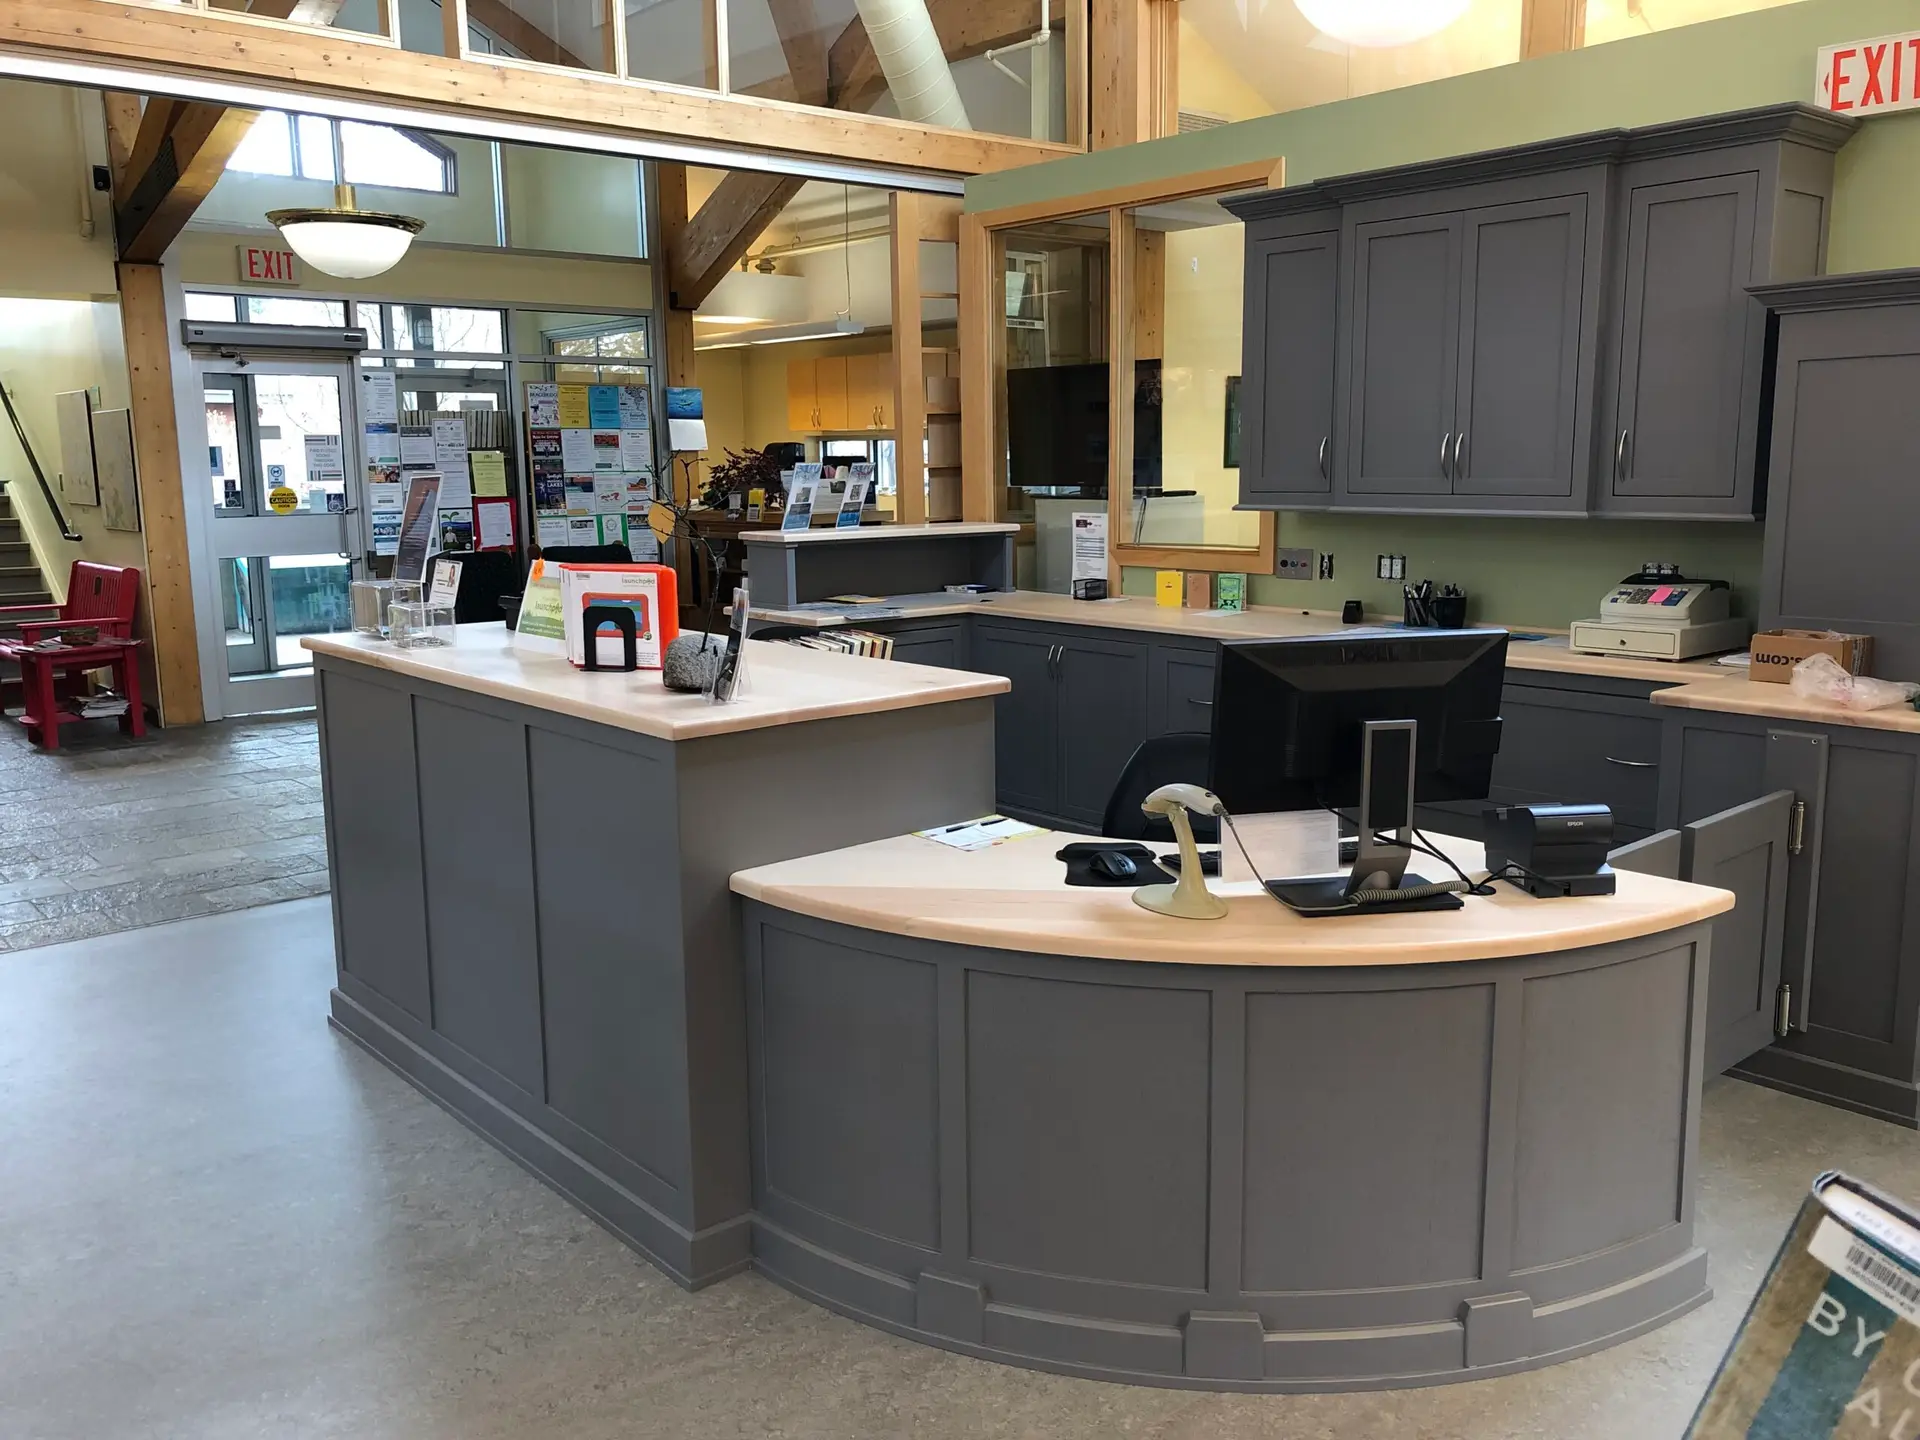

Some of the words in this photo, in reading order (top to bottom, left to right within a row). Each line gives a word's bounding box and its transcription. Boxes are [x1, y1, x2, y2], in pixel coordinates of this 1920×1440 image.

[1830, 38, 1920, 111] EXIT
[248, 249, 293, 280] EXIT
[1807, 1292, 1887, 1358] BY
